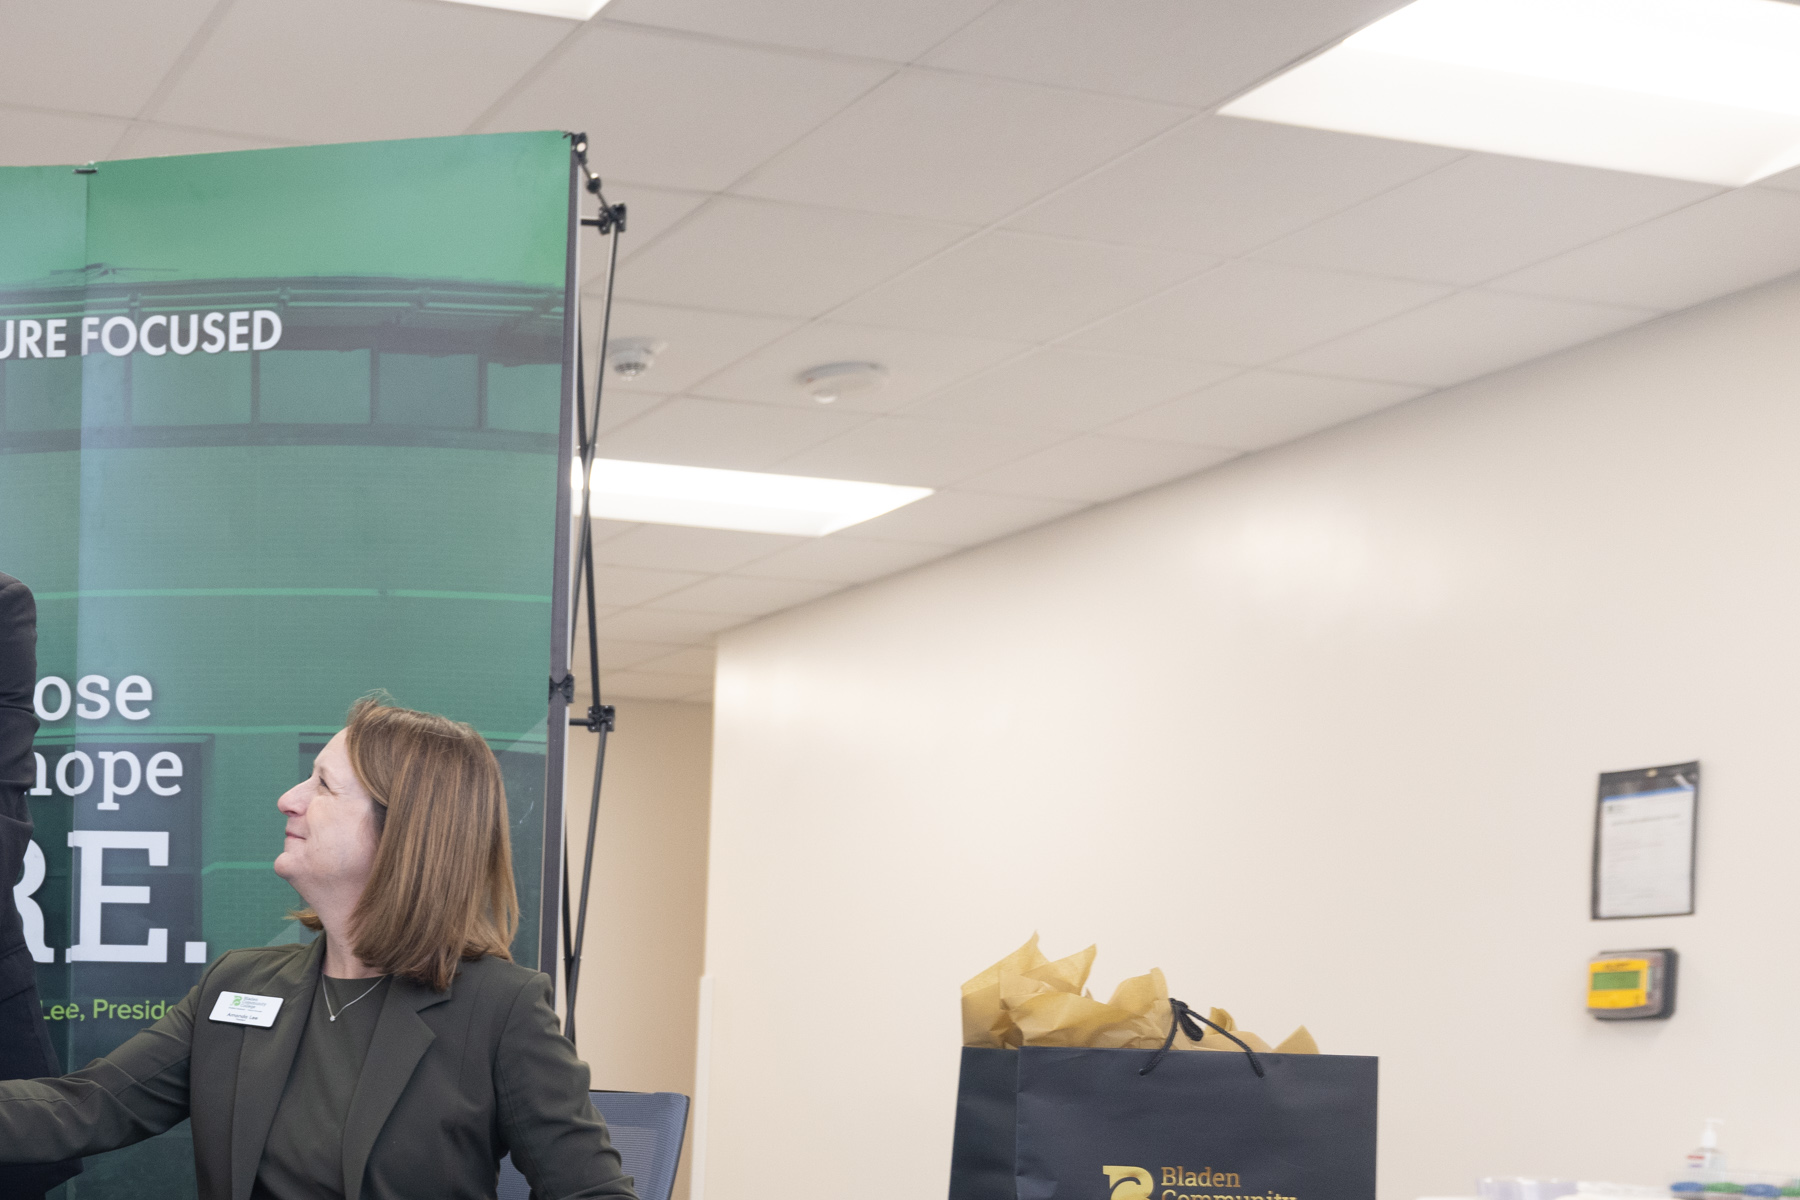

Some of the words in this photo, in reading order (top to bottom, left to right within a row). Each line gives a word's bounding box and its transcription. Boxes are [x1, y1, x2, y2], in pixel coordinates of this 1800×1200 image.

[81, 309, 283, 356] FOCUSED
[33, 674, 153, 721] ose
[92, 998, 175, 1021] Presid
[1161, 1165, 1241, 1188] Bladen
